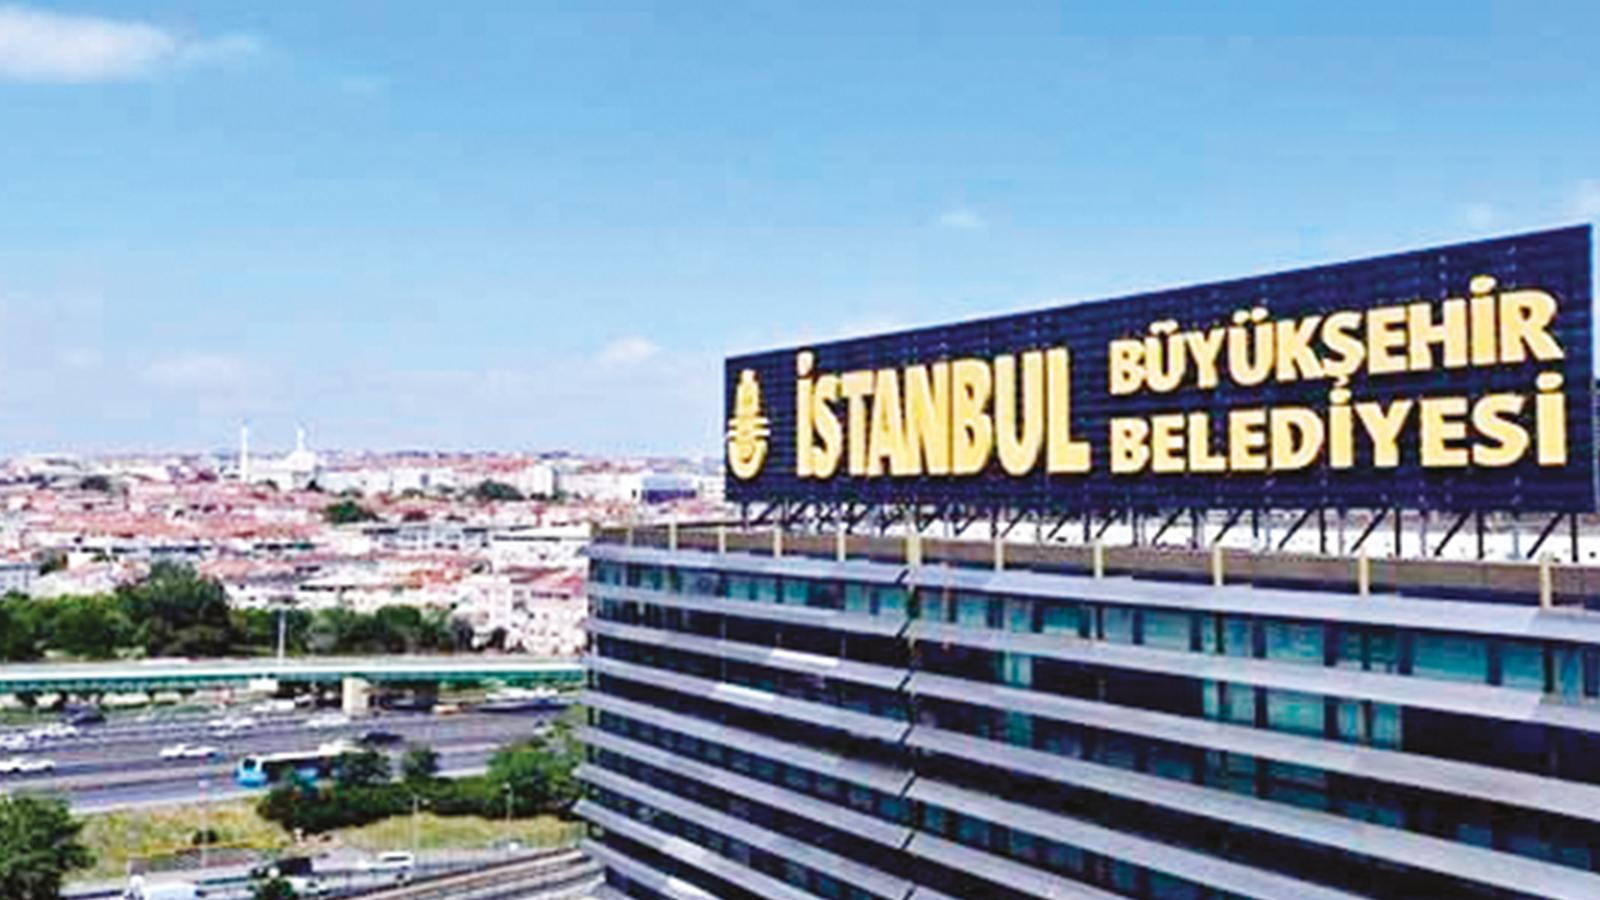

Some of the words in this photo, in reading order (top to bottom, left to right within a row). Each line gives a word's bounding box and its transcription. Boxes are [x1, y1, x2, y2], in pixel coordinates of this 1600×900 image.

[1108, 275, 1564, 395] BÜYÜKŞEHİR
[795, 349, 1091, 477] İSTANBUL
[1110, 372, 1567, 474] BELEDİYESİ
